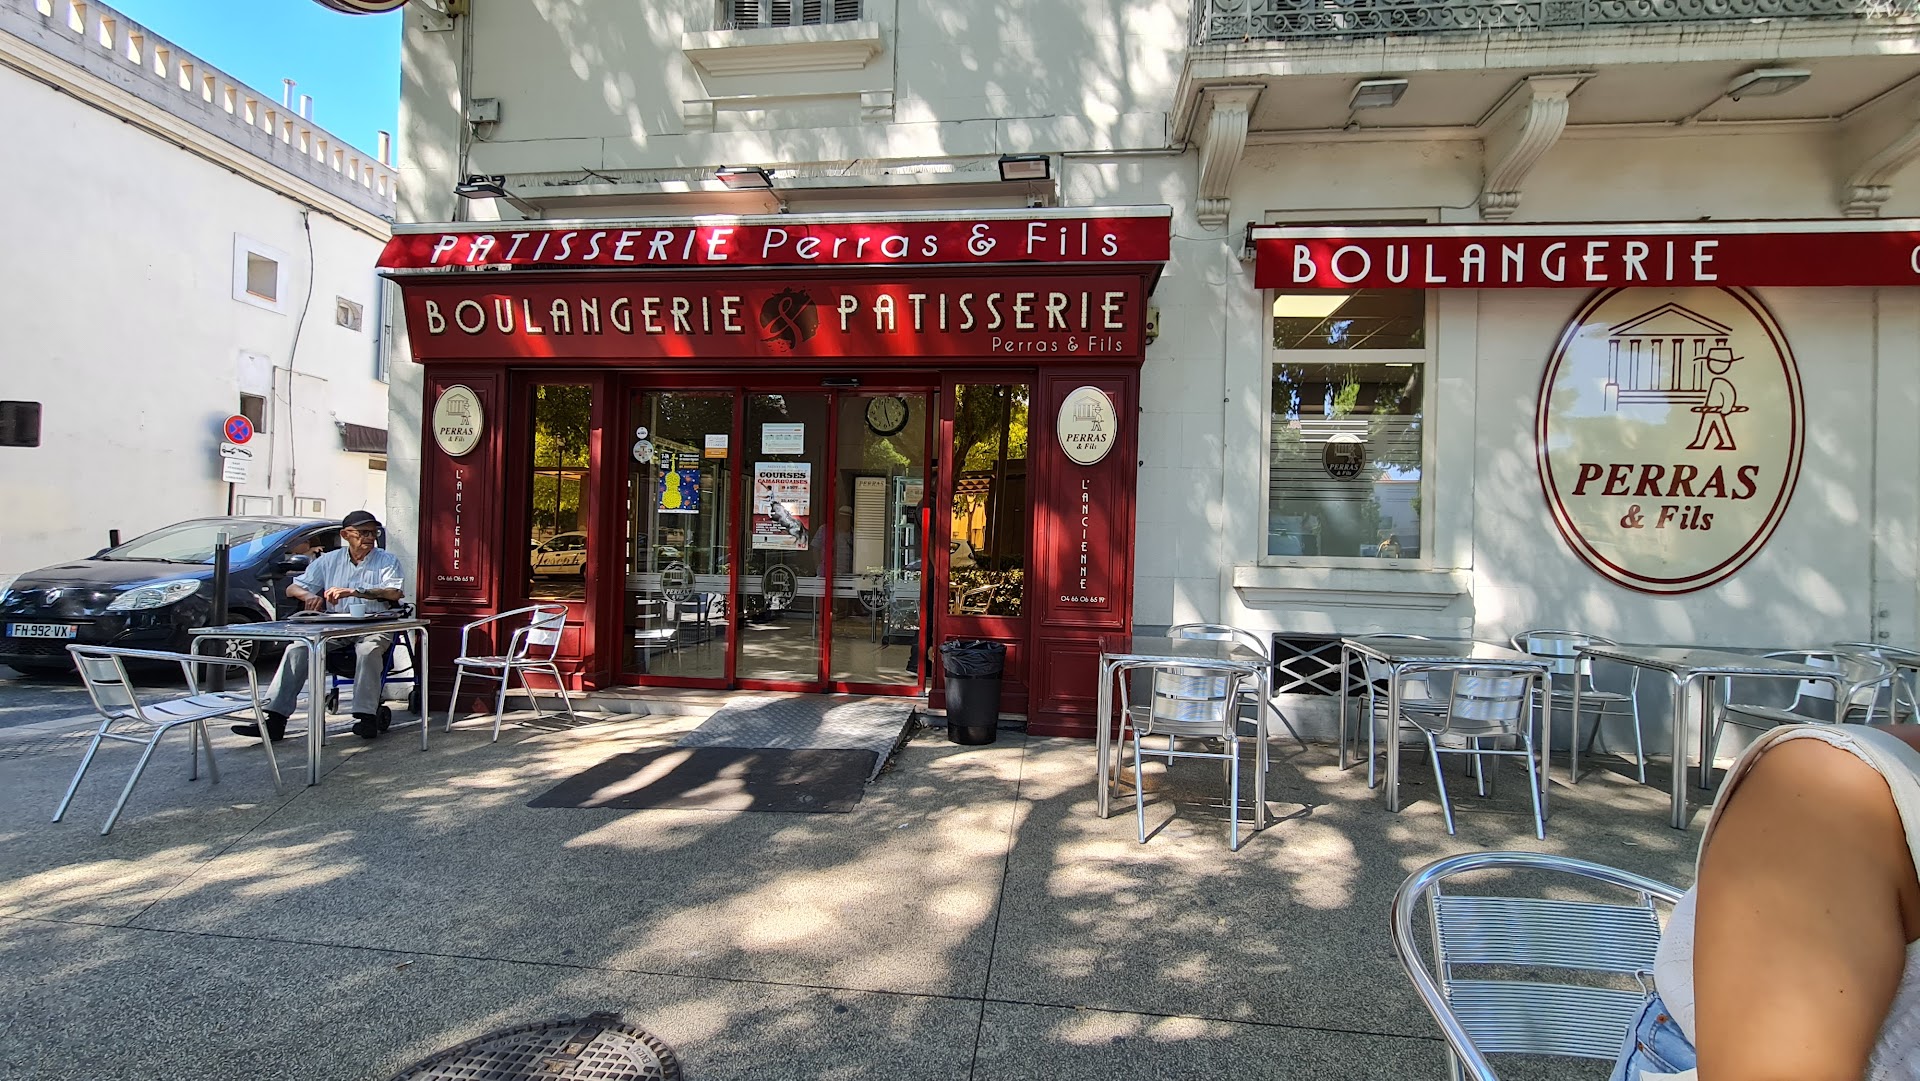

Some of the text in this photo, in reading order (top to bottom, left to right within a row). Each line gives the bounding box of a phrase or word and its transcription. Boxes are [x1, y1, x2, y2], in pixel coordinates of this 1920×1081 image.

[430, 222, 1119, 264] PATISSERIE Perras & Fils
[1293, 240, 1719, 283] BOULANGERIE
[426, 295, 744, 334] BOULANGERIE
[837, 291, 1125, 332] PATISSERIE
[992, 336, 1123, 352] Perras & Fils
[440, 427, 473, 436] PERRAS
[1066, 433, 1107, 443] PERRAS
[760, 471, 806, 479] COURSES
[1330, 463, 1359, 471] PERRAS
[1572, 463, 1759, 500] PERRAS
[1620, 504, 1714, 531] & Fils
[1080, 595, 1089, 603] 06
